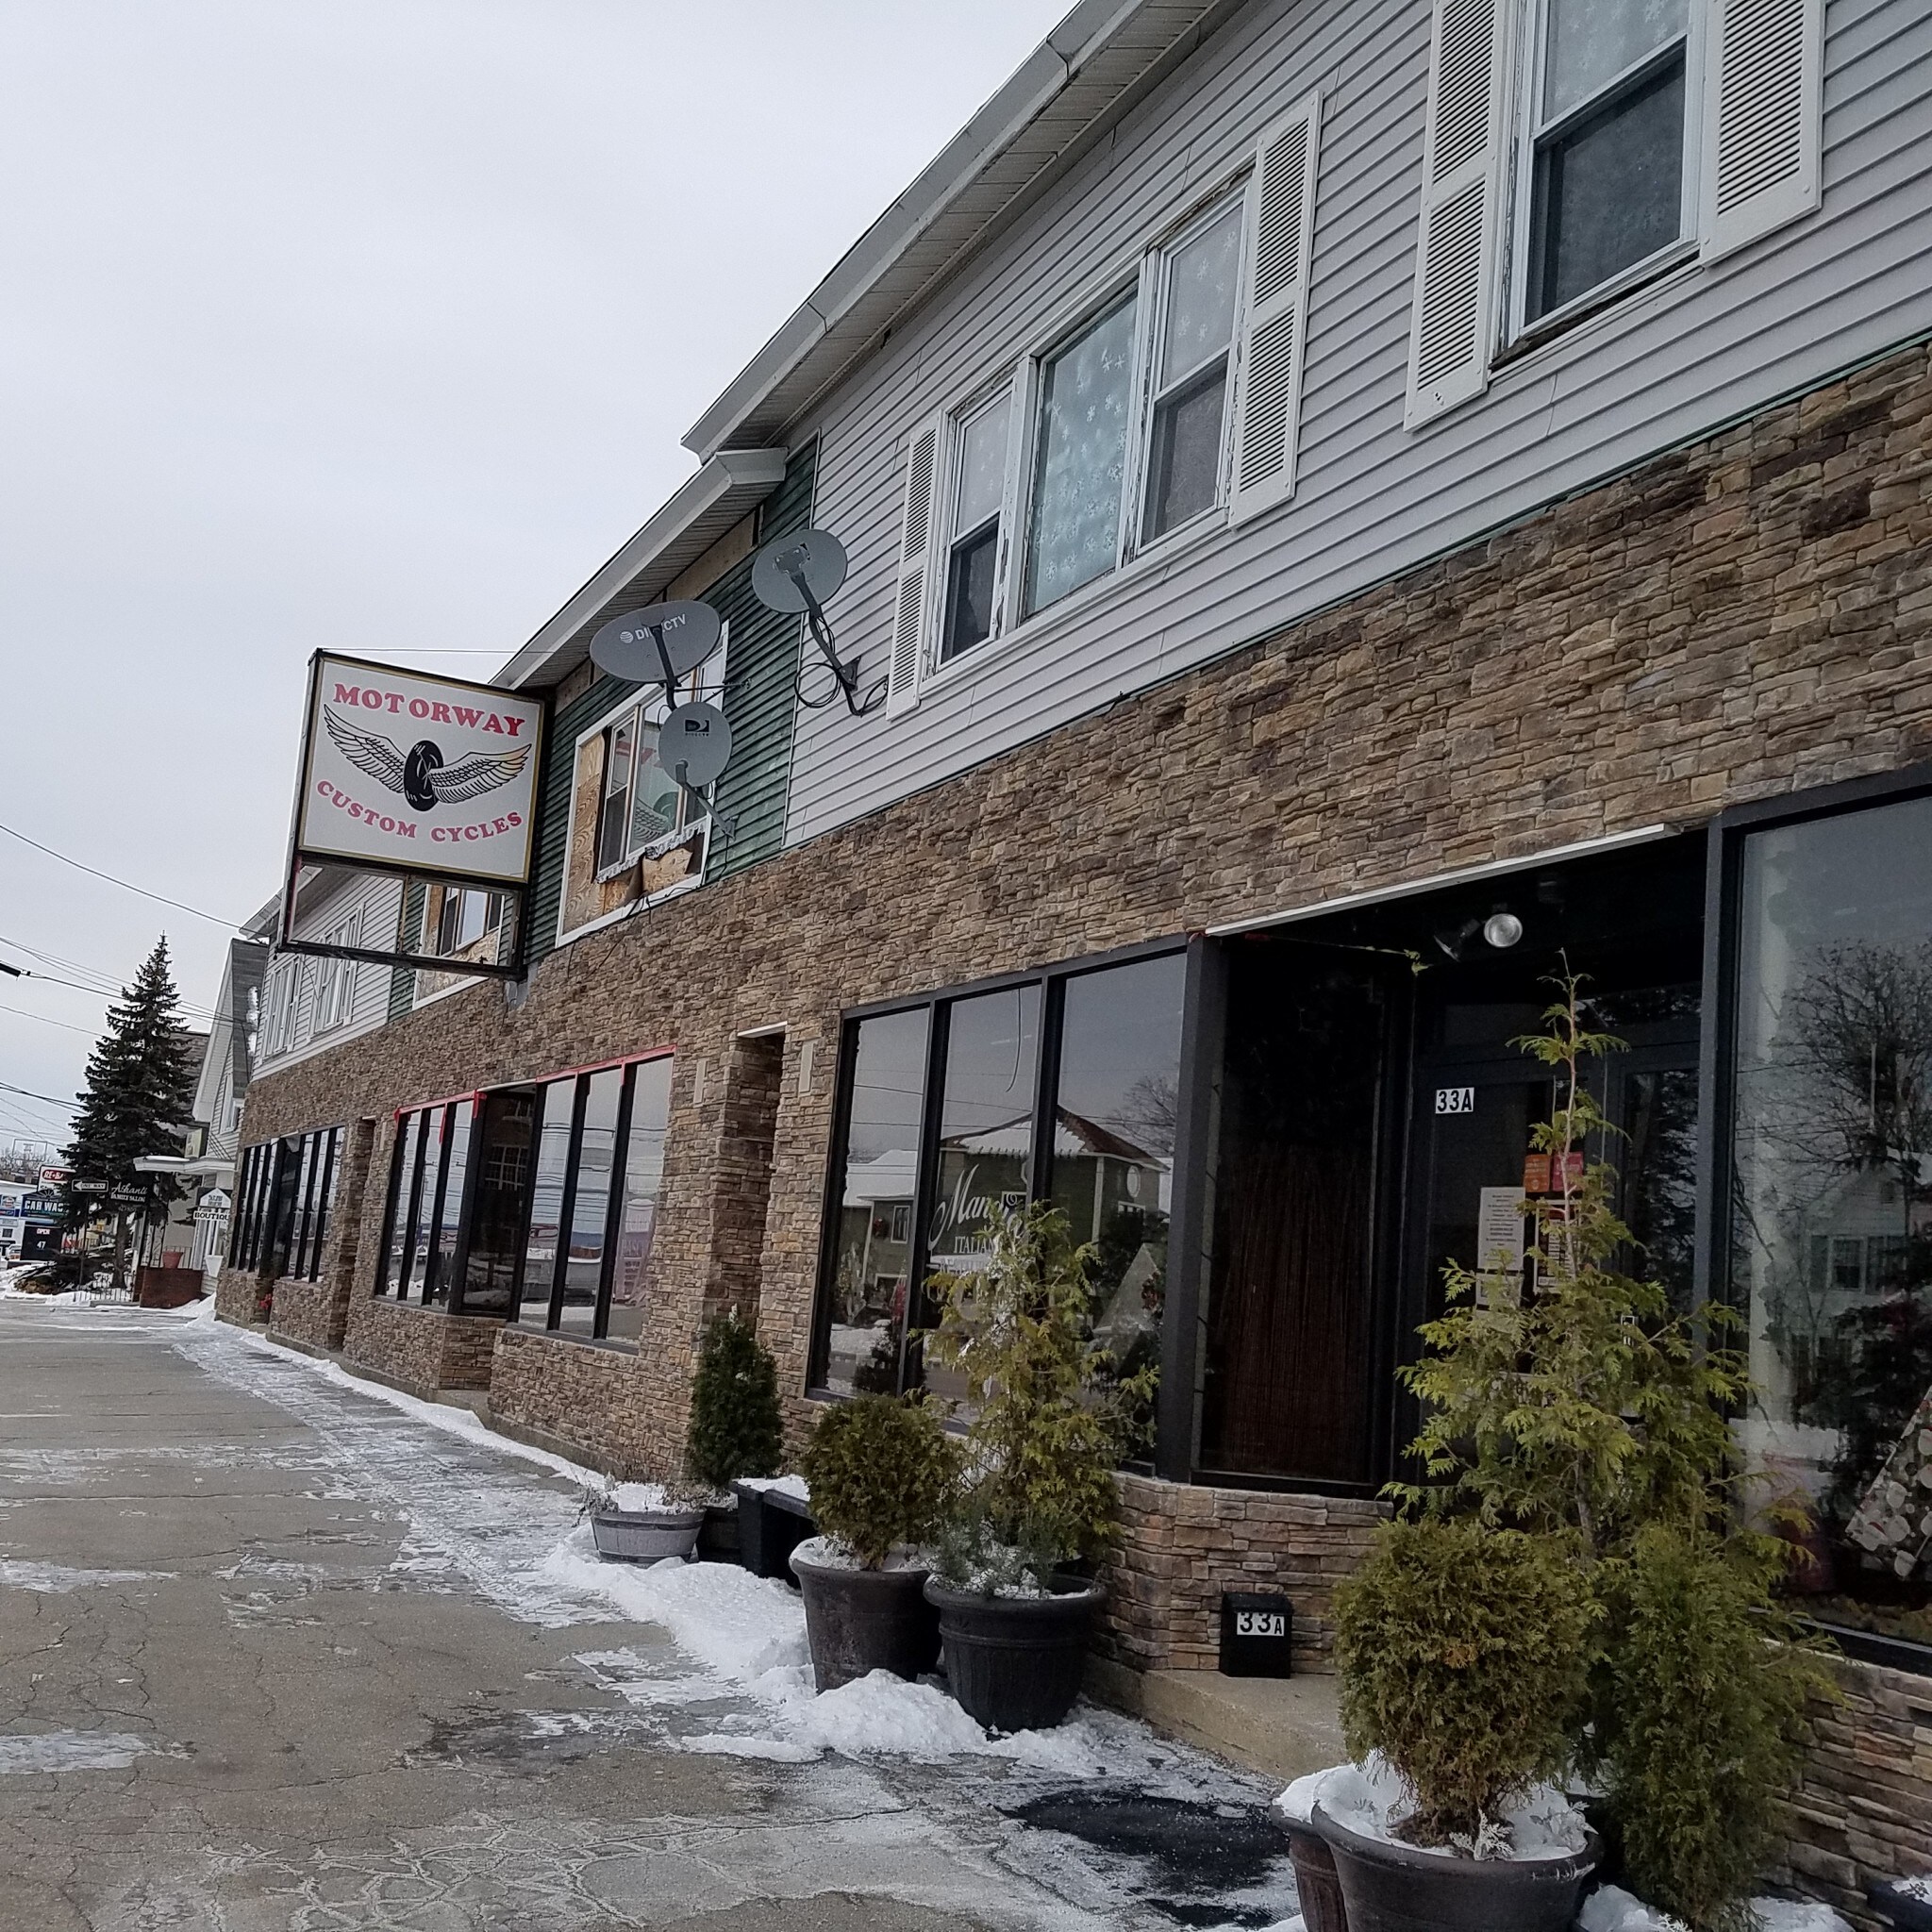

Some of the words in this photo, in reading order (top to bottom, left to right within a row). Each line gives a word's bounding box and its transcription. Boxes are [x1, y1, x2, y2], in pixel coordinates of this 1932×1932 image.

[635, 614, 687, 641] DICTV
[333, 683, 525, 737] MOTORWAY
[317, 780, 418, 839] CUSTOM
[430, 811, 523, 842] CYCLES
[1437, 1090, 1473, 1112] 33A
[25, 1200, 42, 1211] CAR
[194, 1211, 230, 1221] BOUTIQU
[1240, 1612, 1283, 1635] 33A
